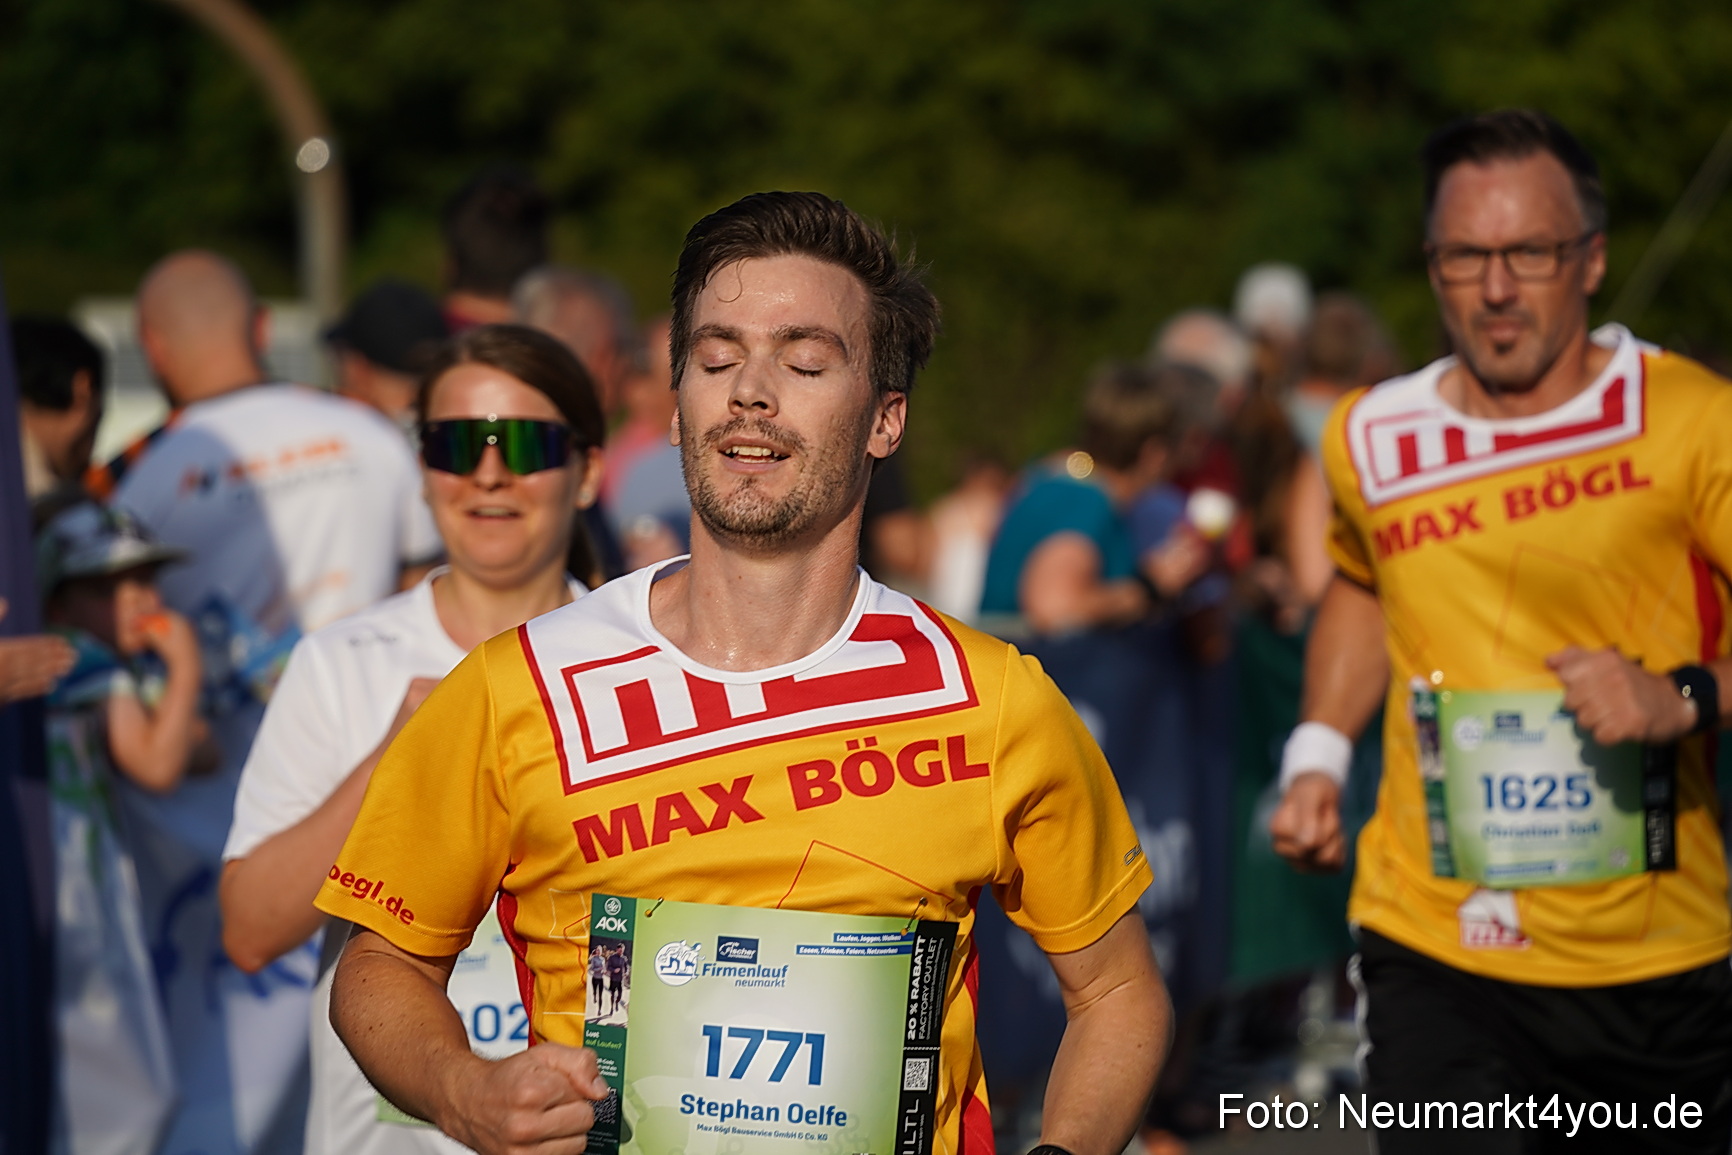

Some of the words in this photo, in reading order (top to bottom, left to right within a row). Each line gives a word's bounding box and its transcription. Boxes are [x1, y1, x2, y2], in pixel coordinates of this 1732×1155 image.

[1372, 499, 1482, 560] MAX
[1504, 457, 1652, 522] BÖGL
[572, 774, 766, 864] MAX
[786, 735, 990, 811] BÖGL
[1481, 774, 1592, 812] 1625
[595, 916, 628, 933] AOK
[718, 941, 756, 957] Fischer
[799, 946, 820, 954] Essen,
[836, 934, 859, 942] Laufen,
[860, 935, 881, 943] Joggen,
[702, 963, 789, 978] Firmenlauf
[911, 935, 926, 999] RABATT
[923, 937, 938, 983] OUTLET
[735, 978, 786, 988] neumarkt
[459, 1002, 529, 1042] 02
[909, 1001, 918, 1016] %
[918, 983, 930, 1040] FACTORY
[908, 1019, 916, 1041] 20
[702, 1024, 826, 1086] 1771
[680, 1094, 779, 1122] Stephan
[788, 1103, 847, 1126] Oelfe
[696, 1123, 712, 1132] Max
[714, 1126, 730, 1135] Bögl
[731, 1127, 772, 1137] Bauservice
[774, 1130, 796, 1139] GmbH
